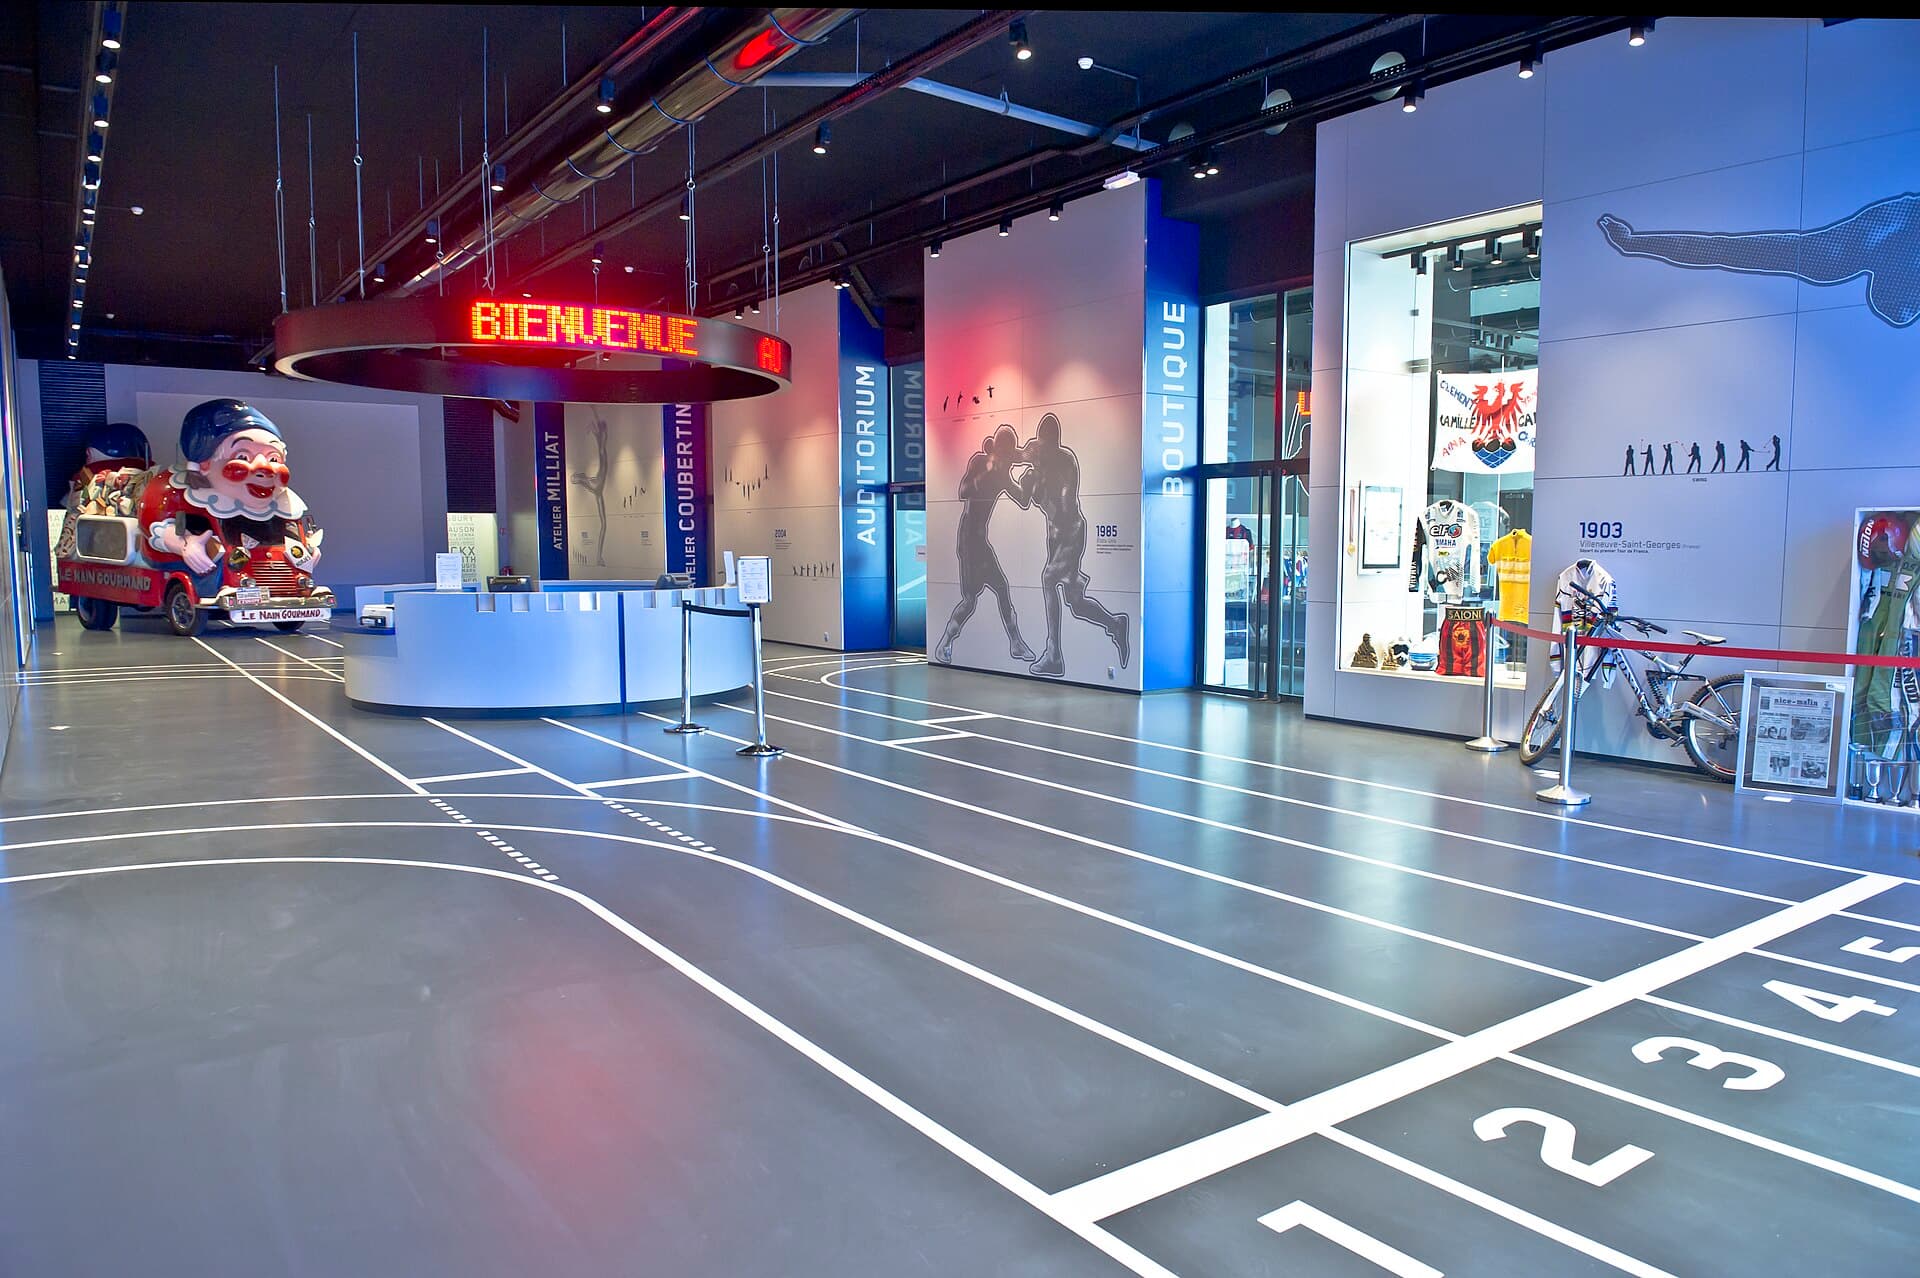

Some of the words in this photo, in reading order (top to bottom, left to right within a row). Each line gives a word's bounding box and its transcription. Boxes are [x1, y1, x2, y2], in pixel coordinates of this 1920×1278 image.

[472, 302, 698, 356] BIENVENUE
[1161, 301, 1188, 498] BOUTIQUE
[545, 431, 561, 501] MILLIAT
[675, 402, 695, 531] COUBERTIN
[855, 365, 876, 546] AUDITORIUM
[552, 505, 563, 550] ATELIER
[1095, 525, 1118, 537] 1985
[1579, 521, 1623, 539] 1903
[1579, 540, 1681, 551] Villeneuve-Saint-Georges
[1860, 519, 1875, 558] NOLAN
[74, 569, 95, 583] NAIN
[96, 574, 151, 591] GOURMAND
[281, 609, 321, 619] GOURMAND
[1761, 979, 1898, 1023] 4
[1631, 1036, 1786, 1091] 3
[1472, 1107, 1656, 1187] 2
[1256, 1200, 1445, 1278] 1
